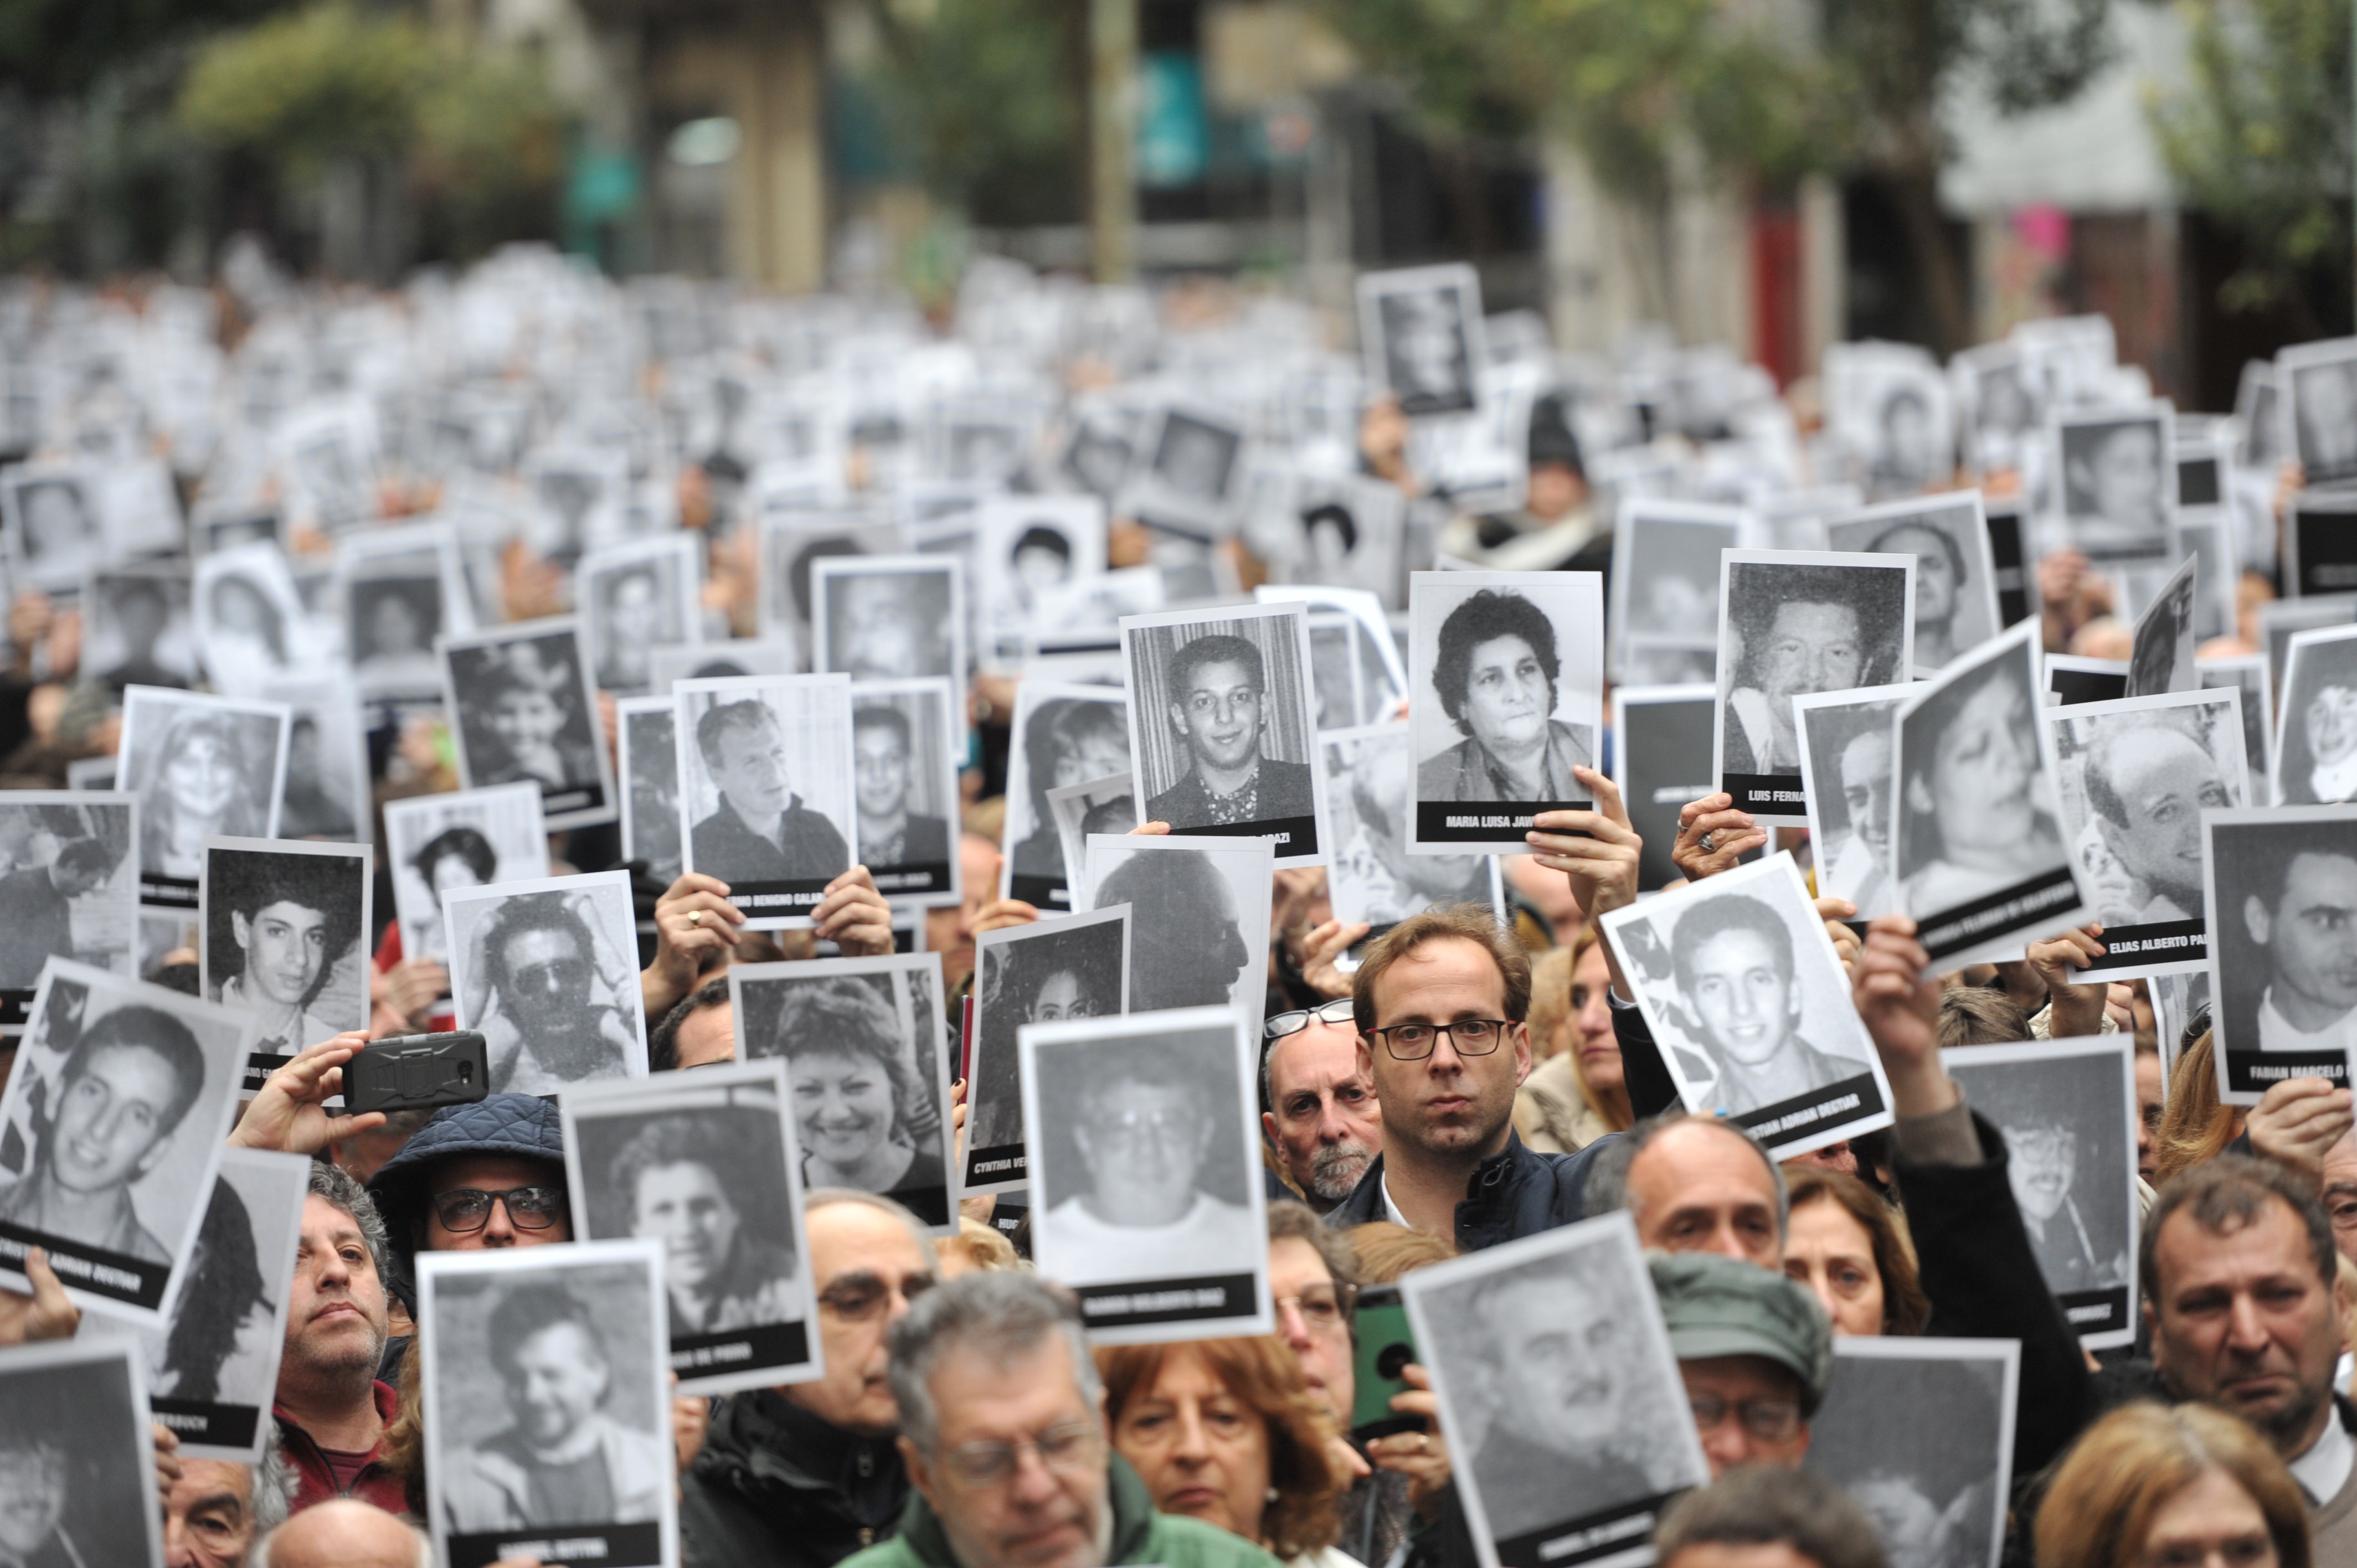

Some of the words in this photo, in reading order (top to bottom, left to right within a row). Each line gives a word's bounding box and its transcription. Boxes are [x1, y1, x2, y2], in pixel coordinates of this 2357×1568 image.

[1748, 790, 1771, 801] LUIS
[1446, 816, 1480, 828] MARIA
[1481, 816, 1511, 828] LUISA
[2109, 940, 2140, 954] ELIAS
[2141, 936, 2188, 951] ALBERTO
[2250, 1065, 2289, 1080] FABIAN
[2291, 1064, 2344, 1079] MARCELO
[974, 1158, 1012, 1174] CYNTHIA
